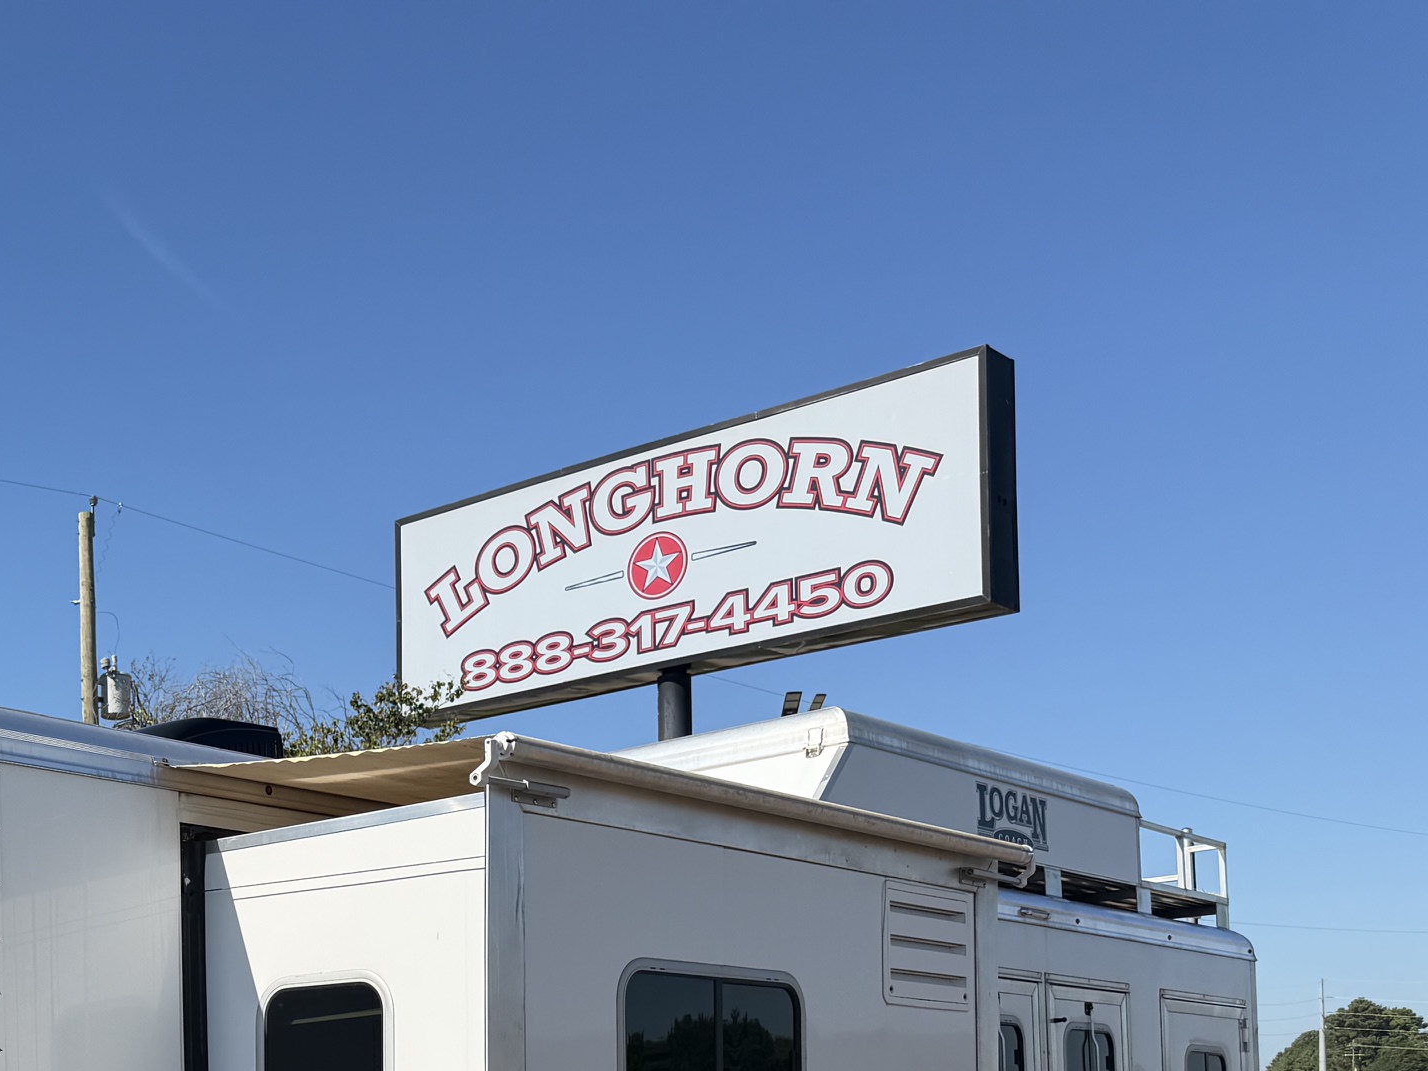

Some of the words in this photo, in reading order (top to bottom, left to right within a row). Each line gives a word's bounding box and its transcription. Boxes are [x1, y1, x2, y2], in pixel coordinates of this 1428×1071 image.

[424, 437, 944, 637] LONGHORN
[461, 560, 894, 691] 888-317-4450
[975, 781, 1047, 845] LOGAN
